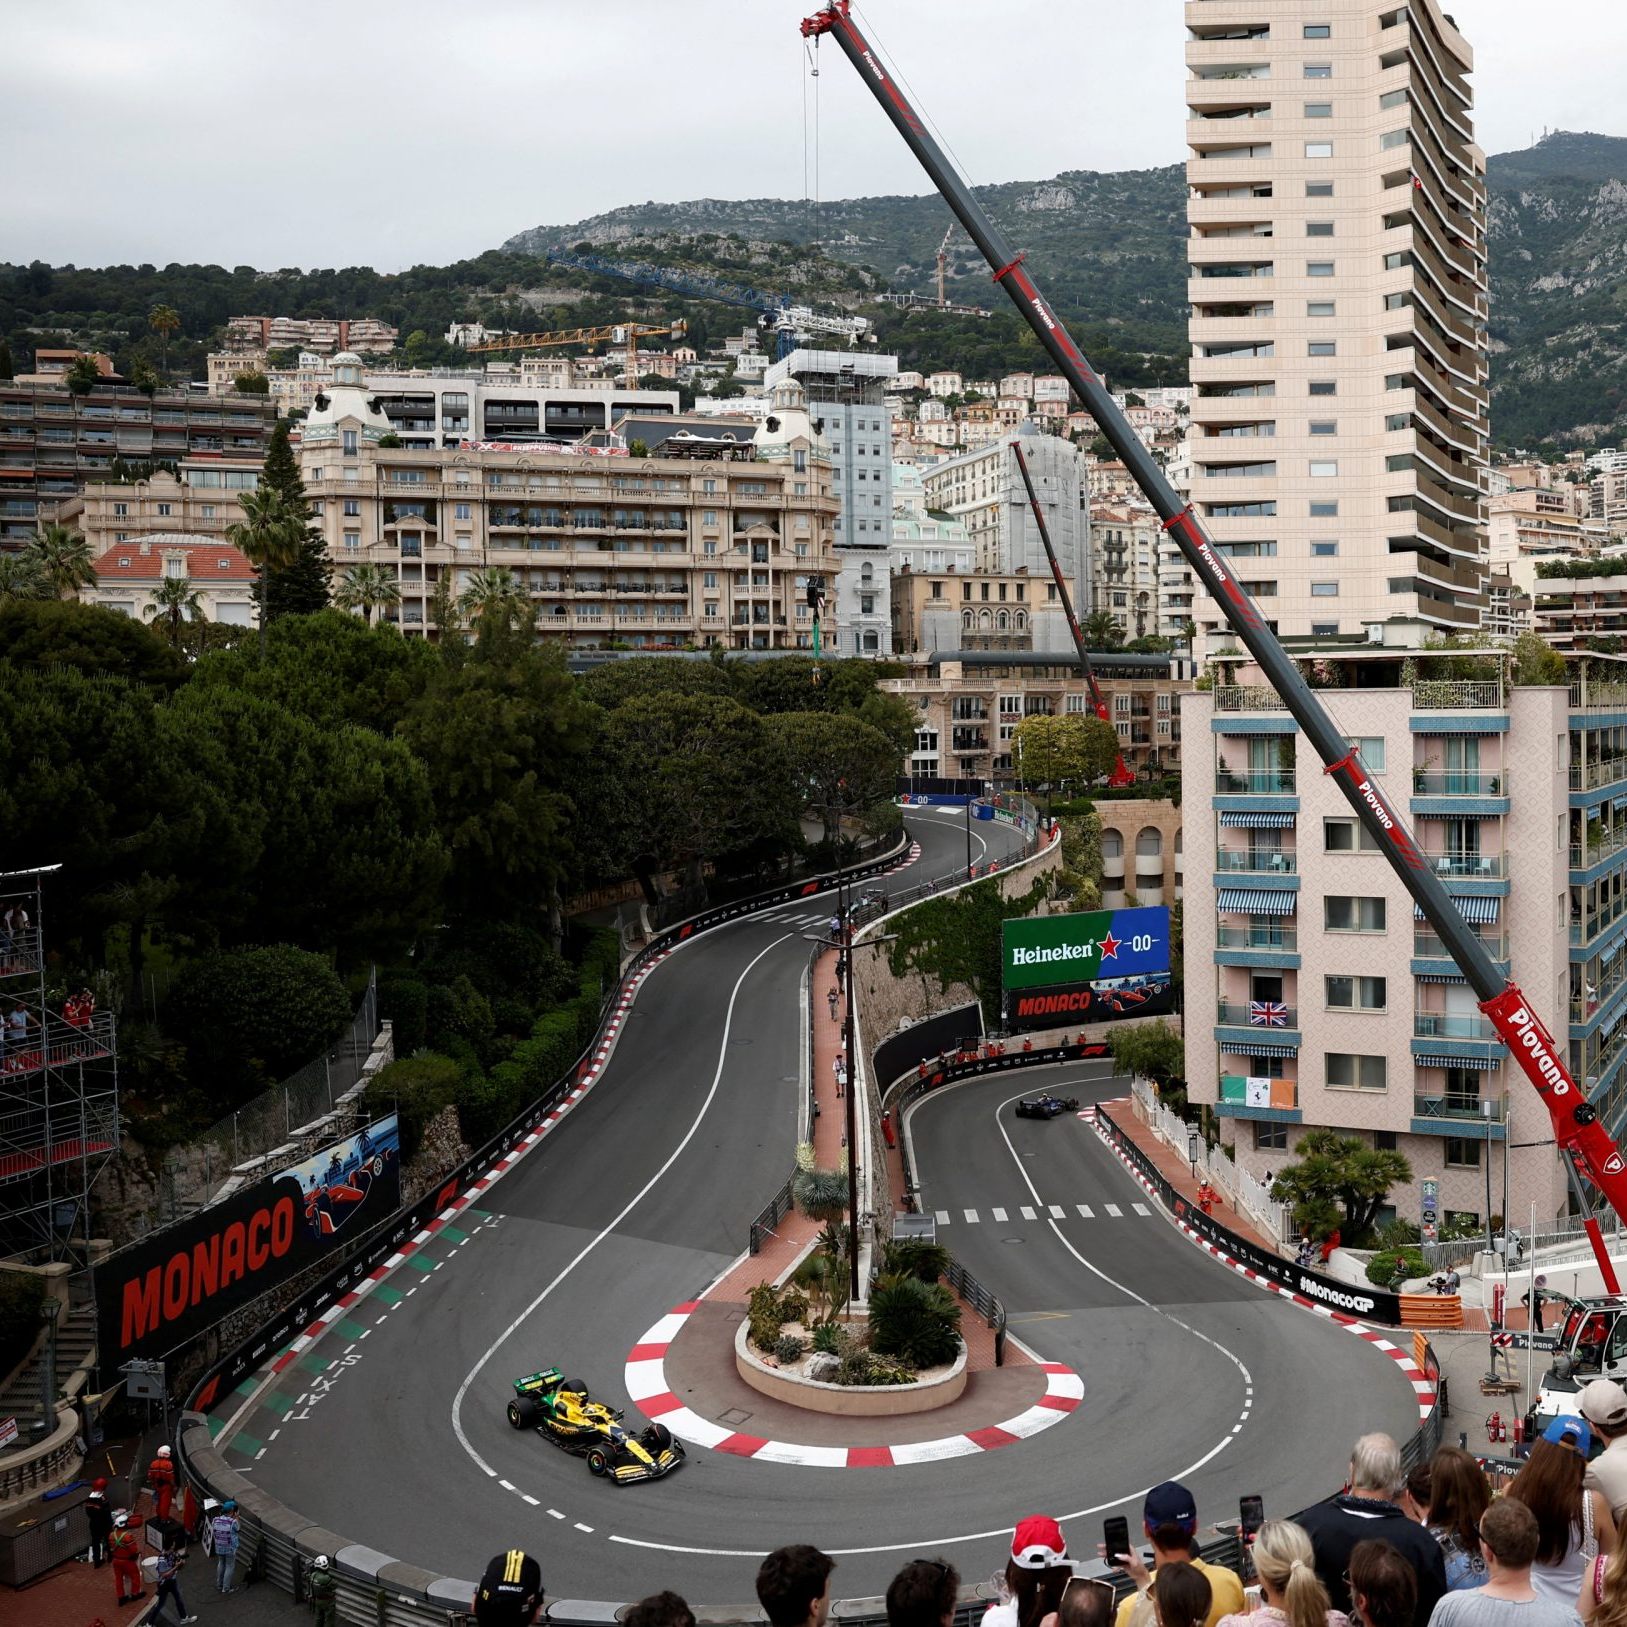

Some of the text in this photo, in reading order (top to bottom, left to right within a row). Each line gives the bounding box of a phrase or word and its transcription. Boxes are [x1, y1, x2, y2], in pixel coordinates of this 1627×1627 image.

[862, 50, 884, 81] Piovano
[1031, 298, 1055, 330] Piovano
[1198, 543, 1227, 582] Piovano
[1358, 780, 1394, 831] Piovano
[1013, 935, 1151, 965] Heineken 0.0
[1018, 992, 1091, 1016] MONACO
[1508, 1007, 1569, 1096] Piovano
[120, 1196, 294, 1349] MONACO
[1300, 1276, 1374, 1313] #MonacoGP
[1519, 1339, 1553, 1349] Pivano
[292, 1353, 362, 1421] TAXIS
[498, 1585, 523, 1593] RENAULT
